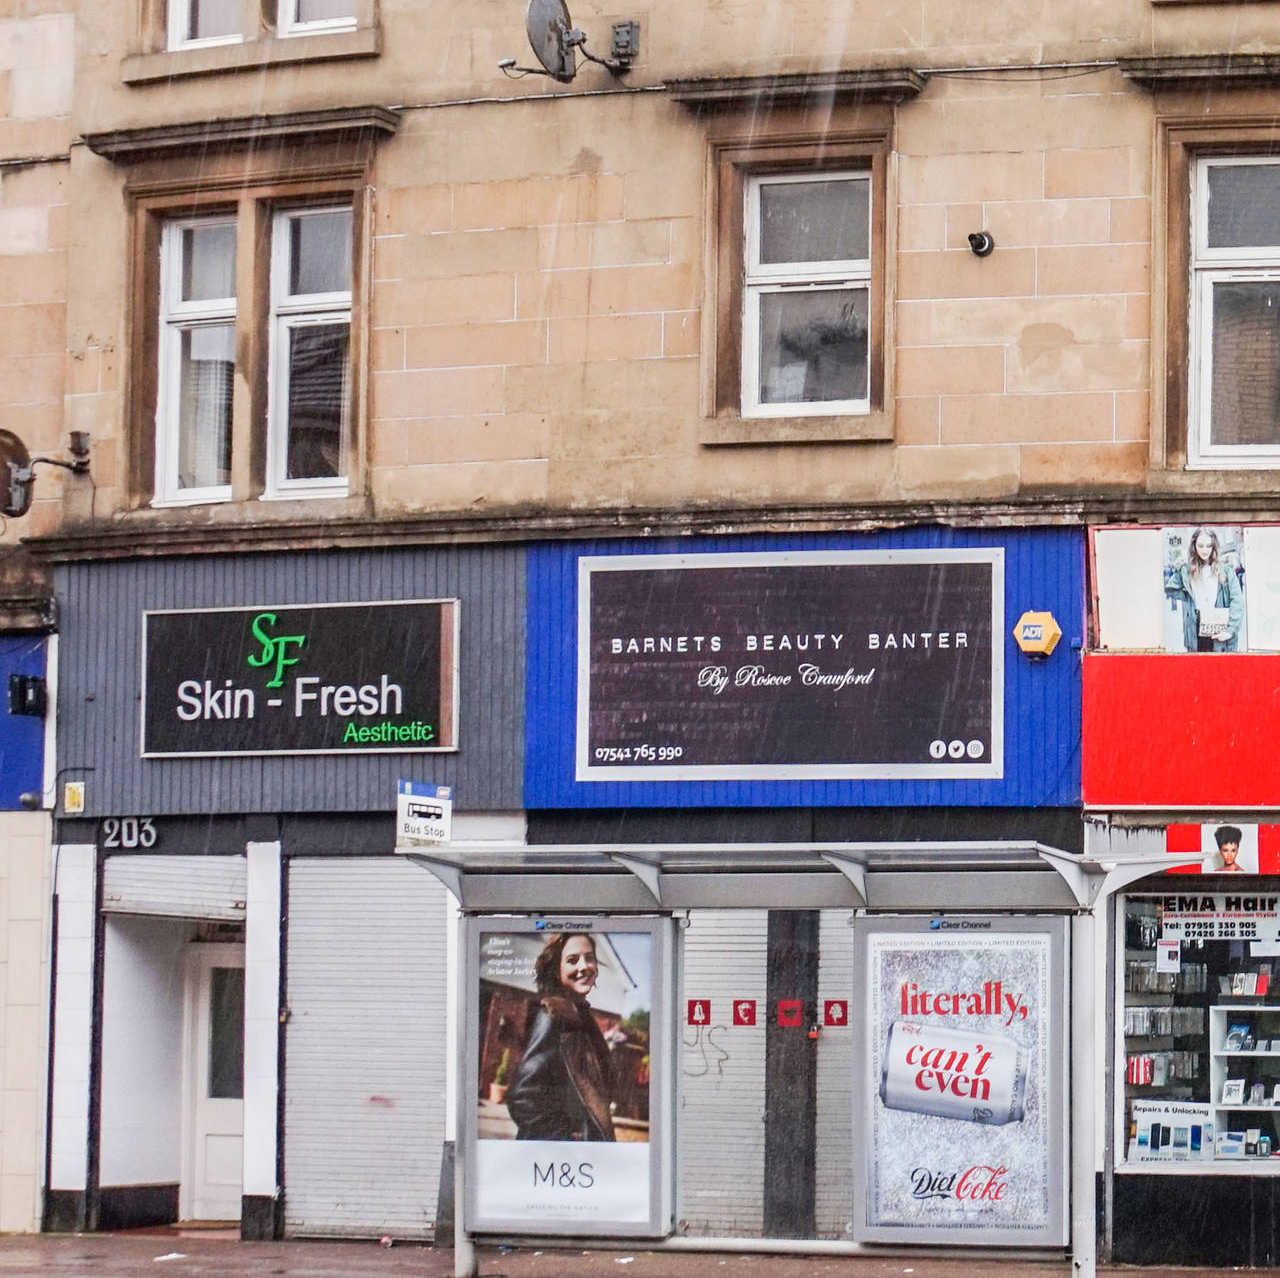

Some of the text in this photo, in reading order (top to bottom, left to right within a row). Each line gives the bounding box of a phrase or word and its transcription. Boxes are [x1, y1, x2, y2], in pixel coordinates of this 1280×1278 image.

[610, 631, 970, 654] BARNETS BEAUTY BANTER
[1023, 626, 1041, 639] ADT
[697, 662, 876, 695] By Roscoe Crawford
[176, 678, 255, 722] Skin
[294, 673, 404, 718] Fresh
[343, 720, 434, 744] Aesthetic
[594, 745, 683, 763] 07541 765 990
[102, 818, 157, 849] 203
[404, 822, 445, 838] Bus Stop
[1163, 895, 1216, 912] EMA
[1225, 895, 1278, 912] Hair
[545, 921, 593, 930] Clear Channel
[941, 921, 992, 930] Clear Channel
[1184, 922, 1216, 930] 07956
[1218, 922, 1236, 930] 330
[1238, 922, 1257, 930] 905
[900, 980, 1028, 1027] literally,
[905, 1044, 994, 1076] can't
[915, 1068, 991, 1101] even
[1134, 1105, 1162, 1114] Repairs
[1172, 1107, 1209, 1117] Unlocking
[533, 1161, 594, 1189] M&S
[910, 1164, 1009, 1202] Diet Coke
